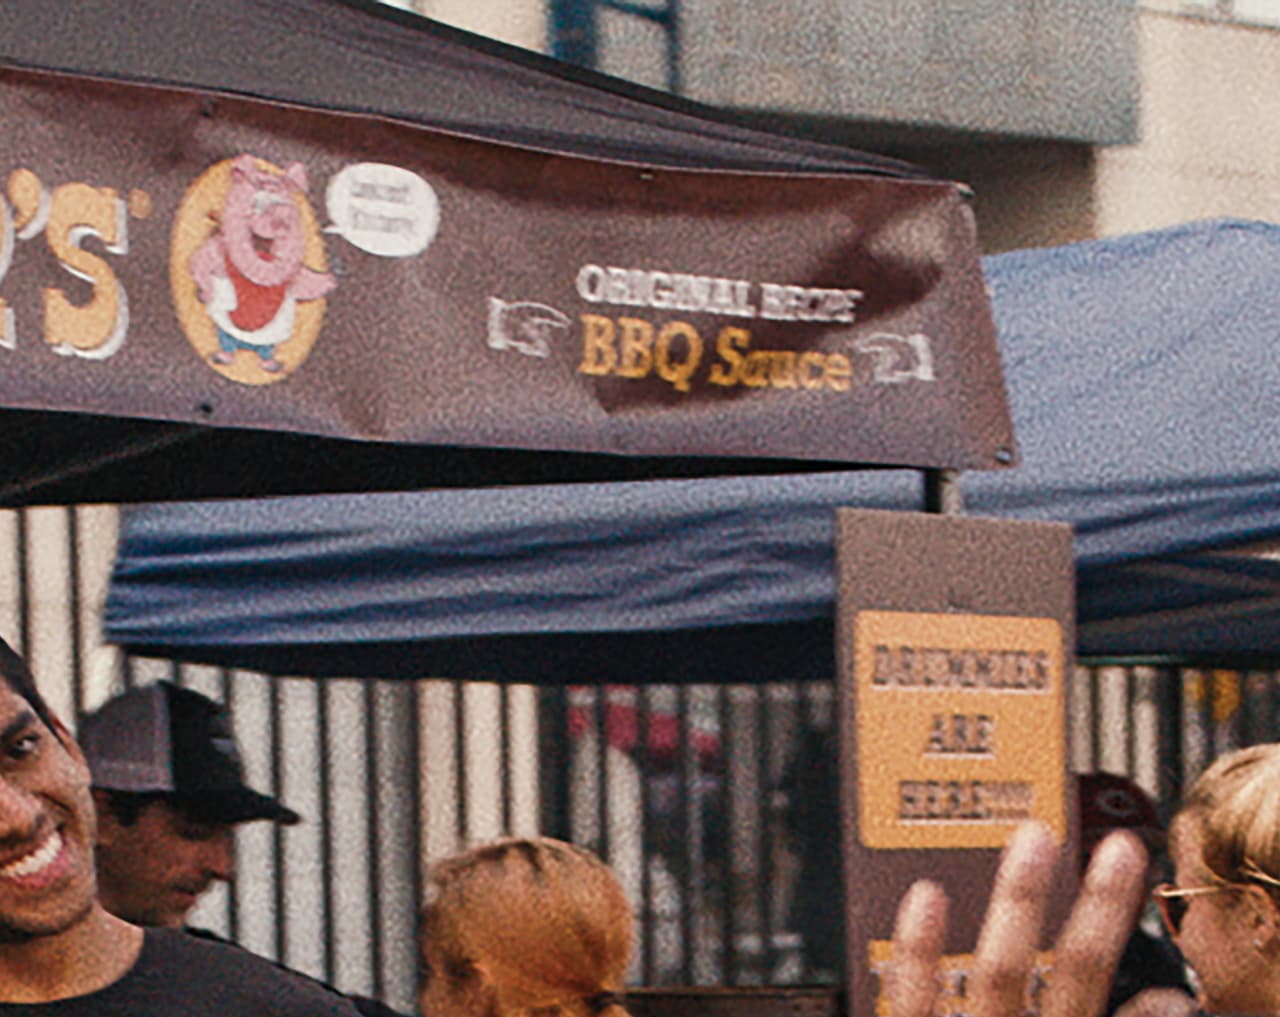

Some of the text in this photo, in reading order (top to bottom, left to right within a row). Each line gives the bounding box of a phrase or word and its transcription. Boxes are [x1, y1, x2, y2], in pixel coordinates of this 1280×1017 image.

[575, 263, 756, 319] ORIGINAL
[577, 313, 853, 393] BBQ Sauce
[871, 644, 1051, 694] DRUMMIES
[923, 712, 996, 760] ARE
